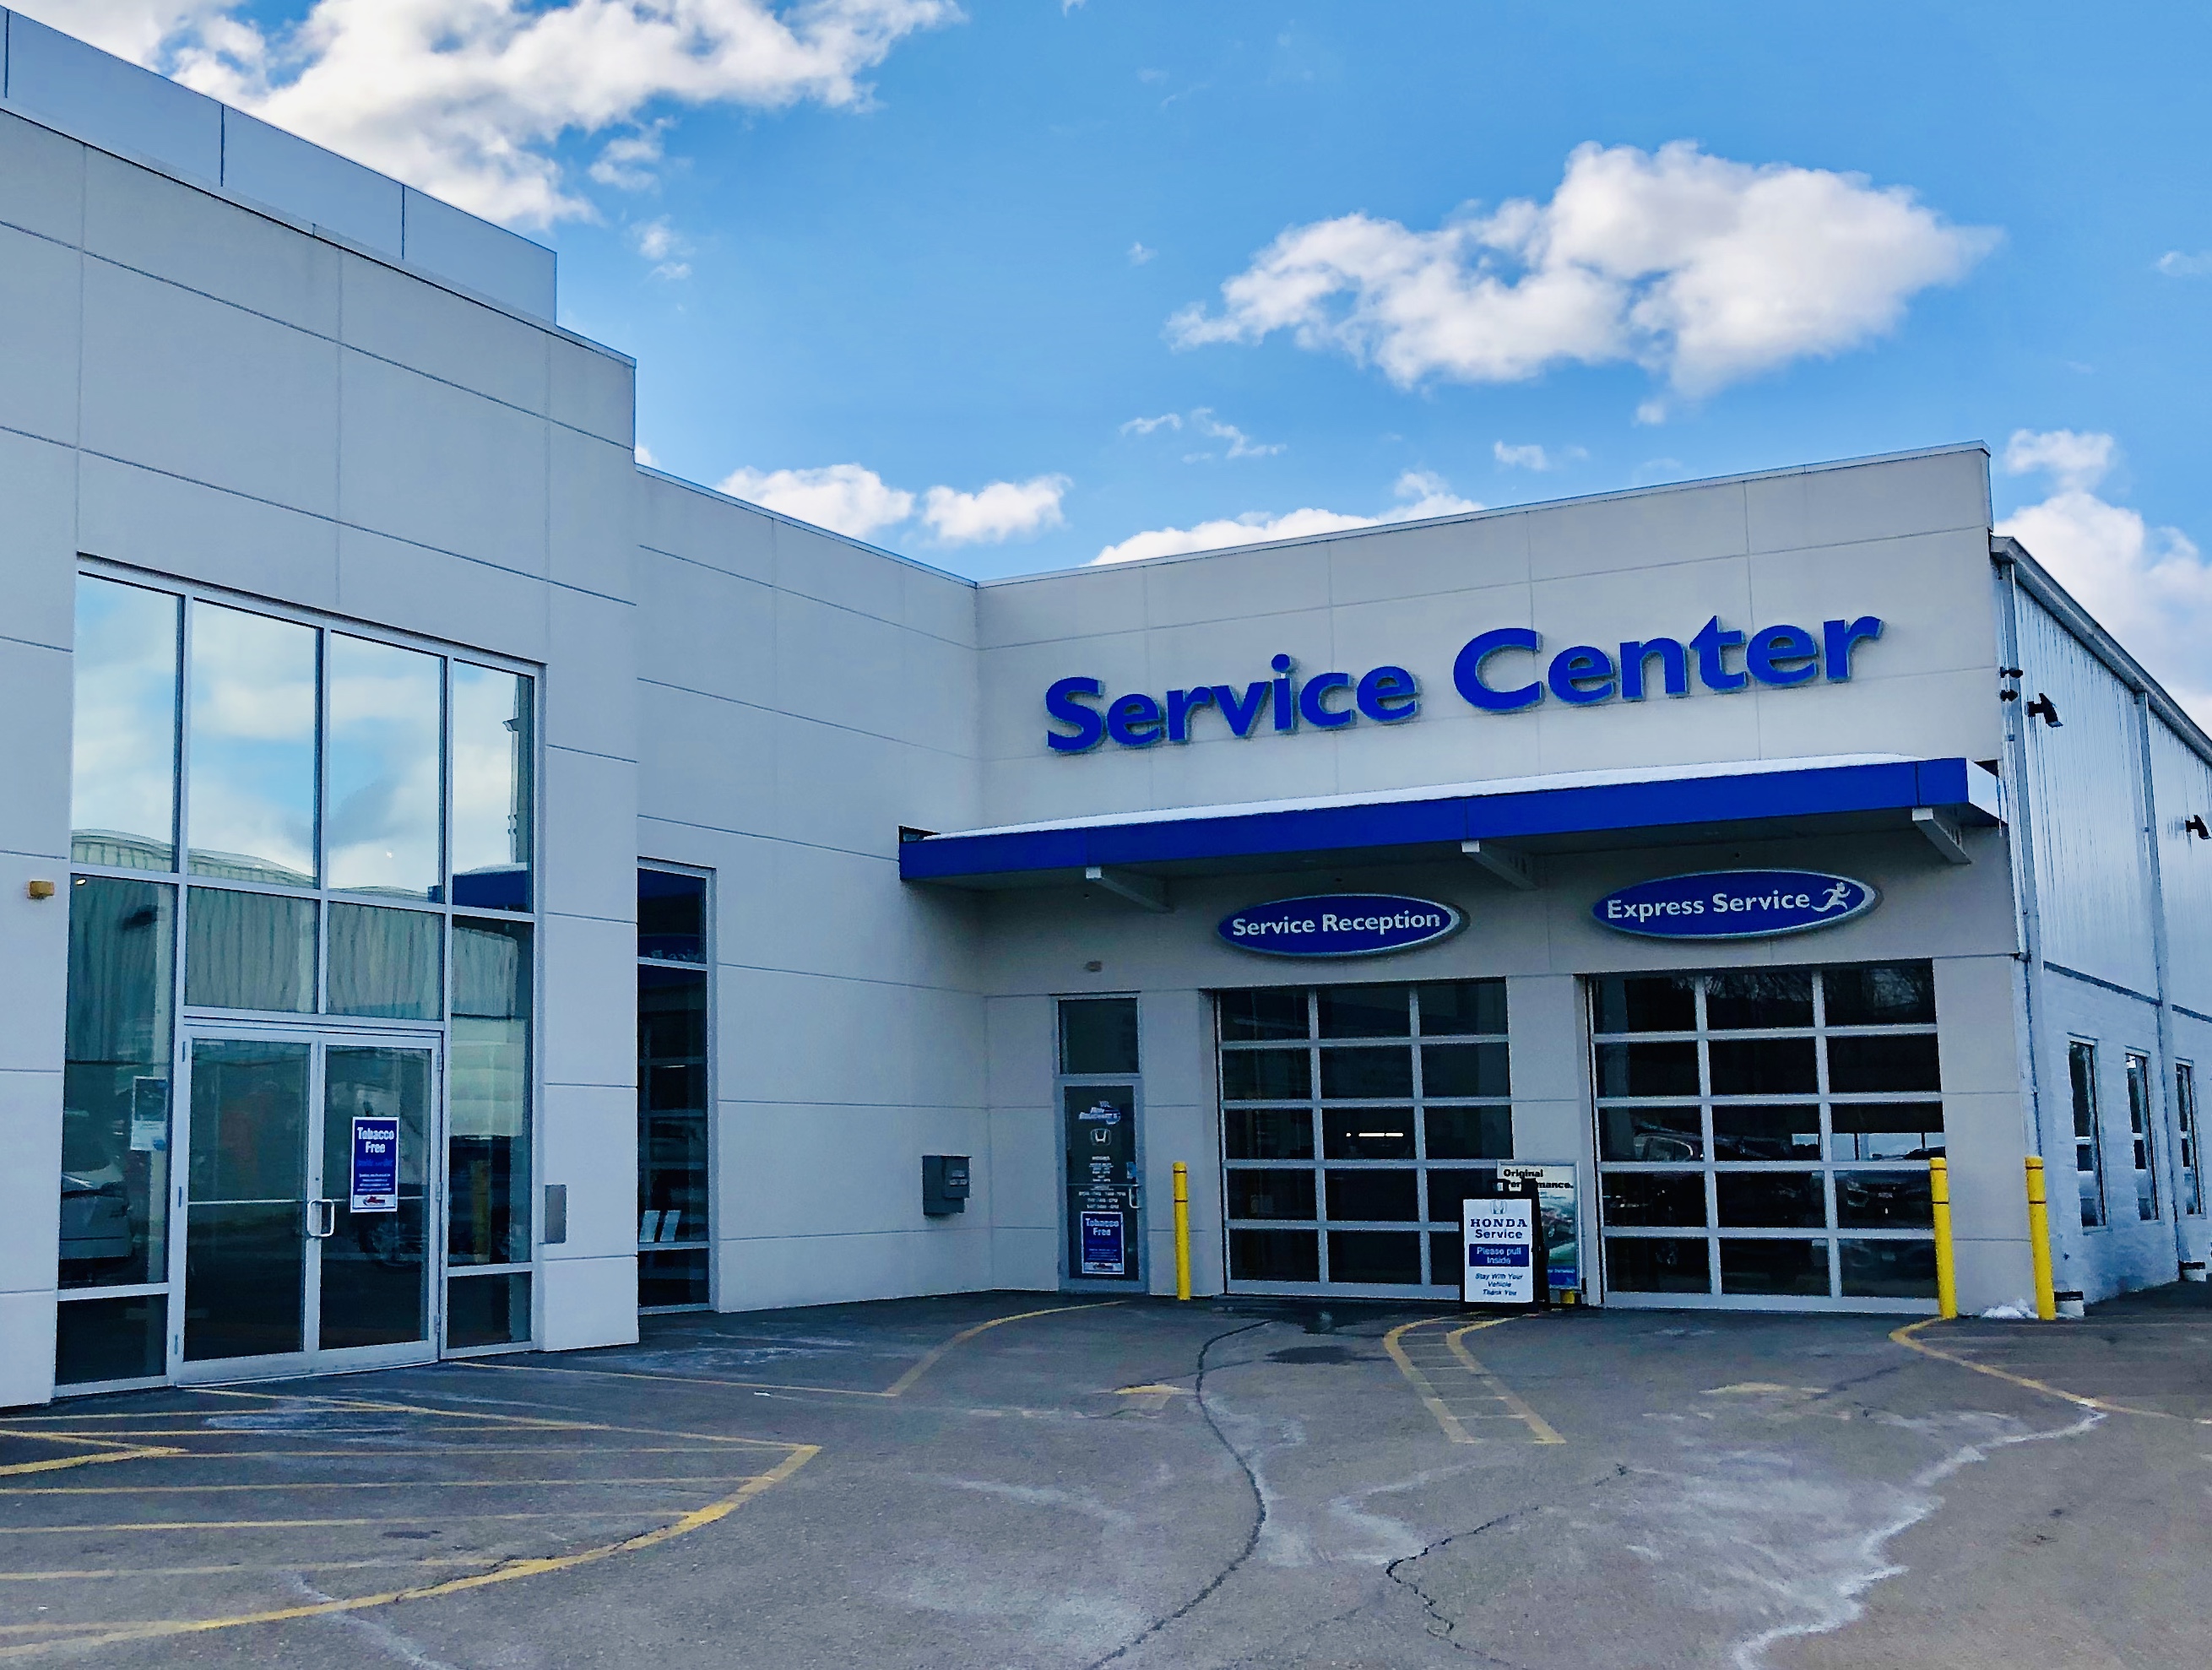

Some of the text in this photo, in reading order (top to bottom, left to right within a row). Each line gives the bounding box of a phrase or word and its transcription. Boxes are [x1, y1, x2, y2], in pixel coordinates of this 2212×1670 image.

[1045, 615, 1884, 753] Service Center
[1607, 889, 1811, 923] Express Service
[1232, 910, 1440, 936] Service Reception
[357, 1126, 395, 1140] Tobacco
[365, 1141, 386, 1153] Free
[1503, 1168, 1544, 1179] Original
[1085, 1217, 1120, 1228] Tobacco
[1470, 1218, 1528, 1228] HONDA
[1092, 1228, 1111, 1236] Free
[1475, 1228, 1523, 1239] Service
[1477, 1246, 1521, 1256] Please pull
[1475, 1272, 1490, 1281] Stay
